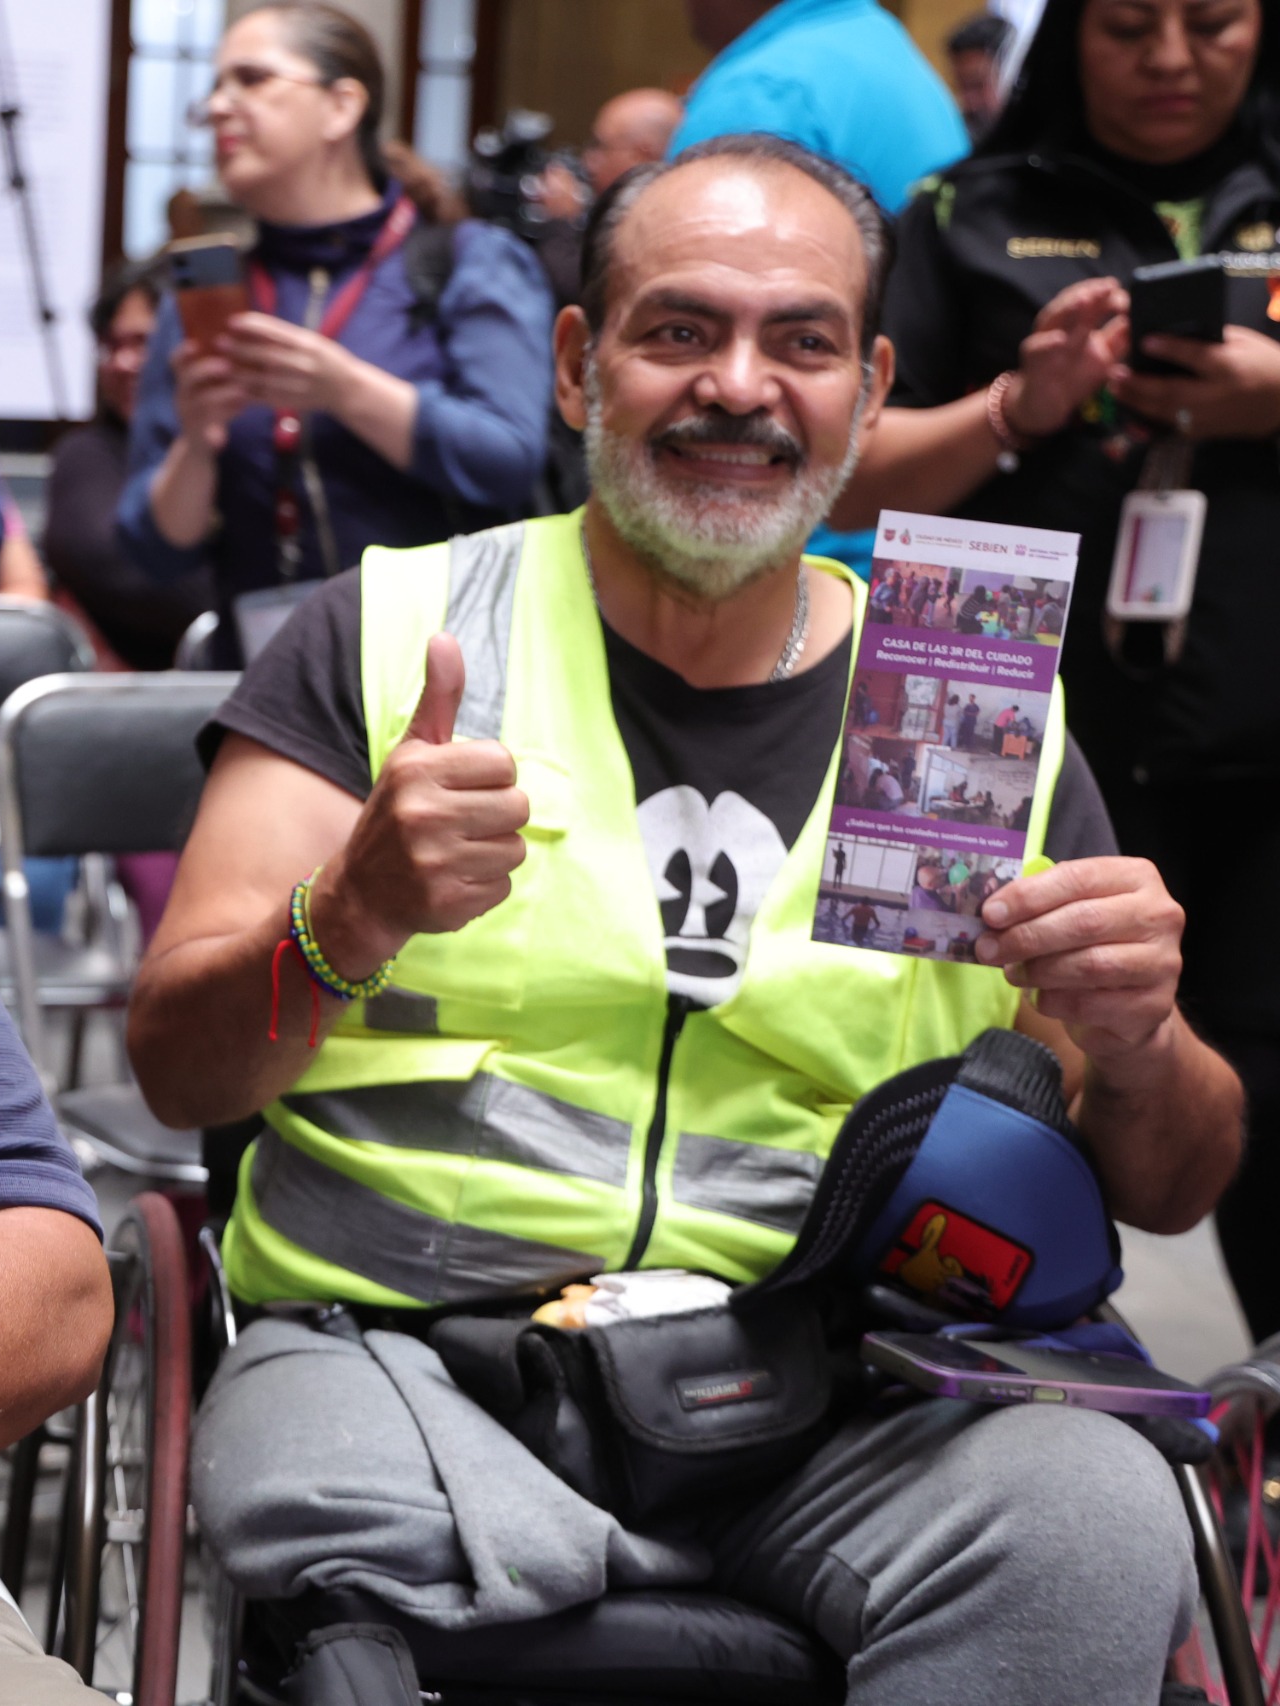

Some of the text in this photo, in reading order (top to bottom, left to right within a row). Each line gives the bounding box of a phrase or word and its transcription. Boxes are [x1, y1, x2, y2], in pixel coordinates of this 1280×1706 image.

[969, 540, 1008, 554] SEBIEN
[876, 650, 1035, 679] Reconocer Redistribuir Reducir
[882, 637, 1033, 666] CASA DE LAS 3R DEL CUIDADO
